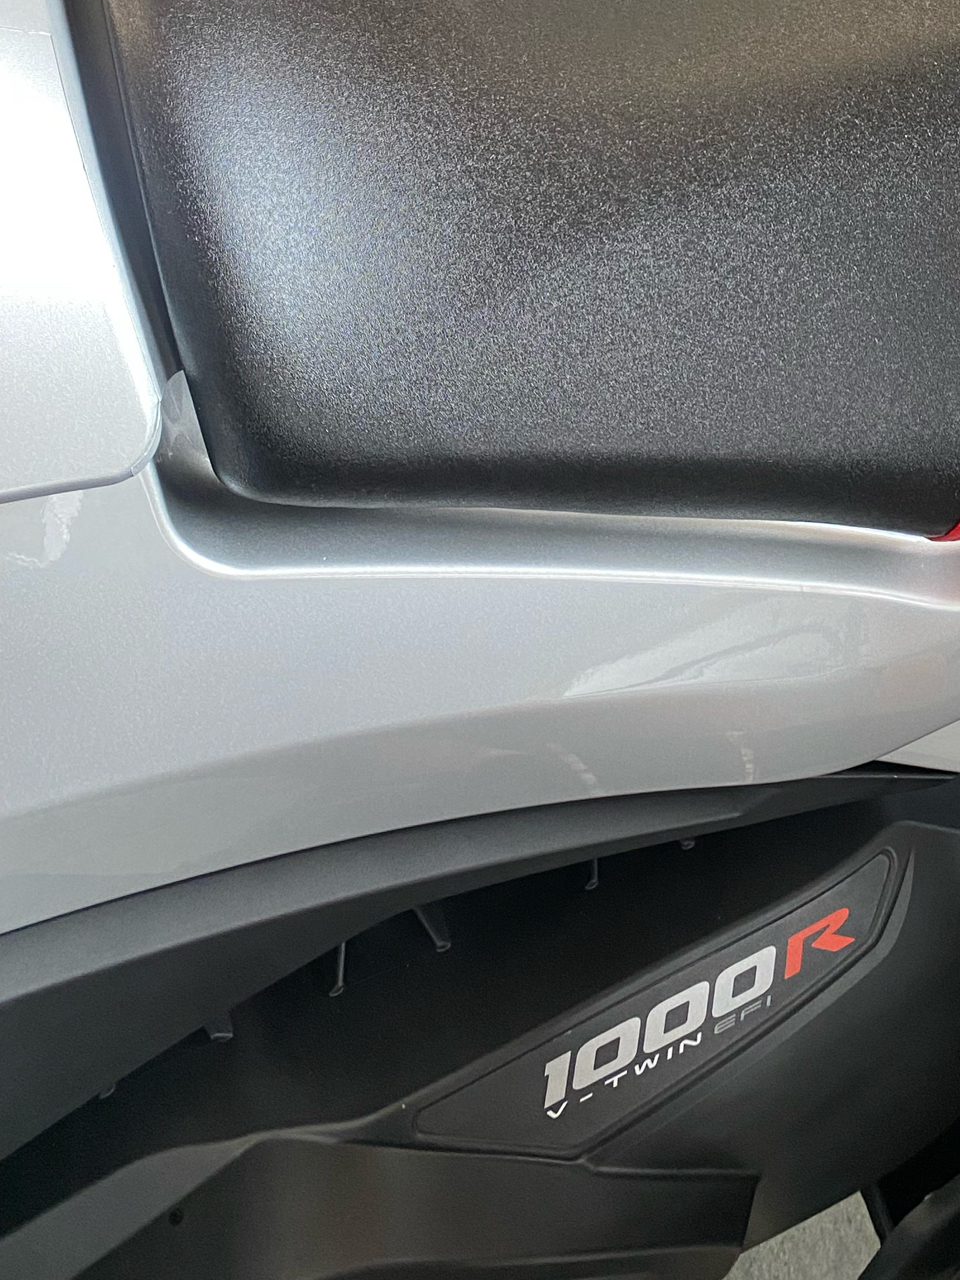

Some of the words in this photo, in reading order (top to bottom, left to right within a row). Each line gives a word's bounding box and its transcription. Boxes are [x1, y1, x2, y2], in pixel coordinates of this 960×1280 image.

[544, 907, 855, 1108] 1000R
[547, 1032, 702, 1120] V-TWIN
[714, 995, 772, 1035] EFI
